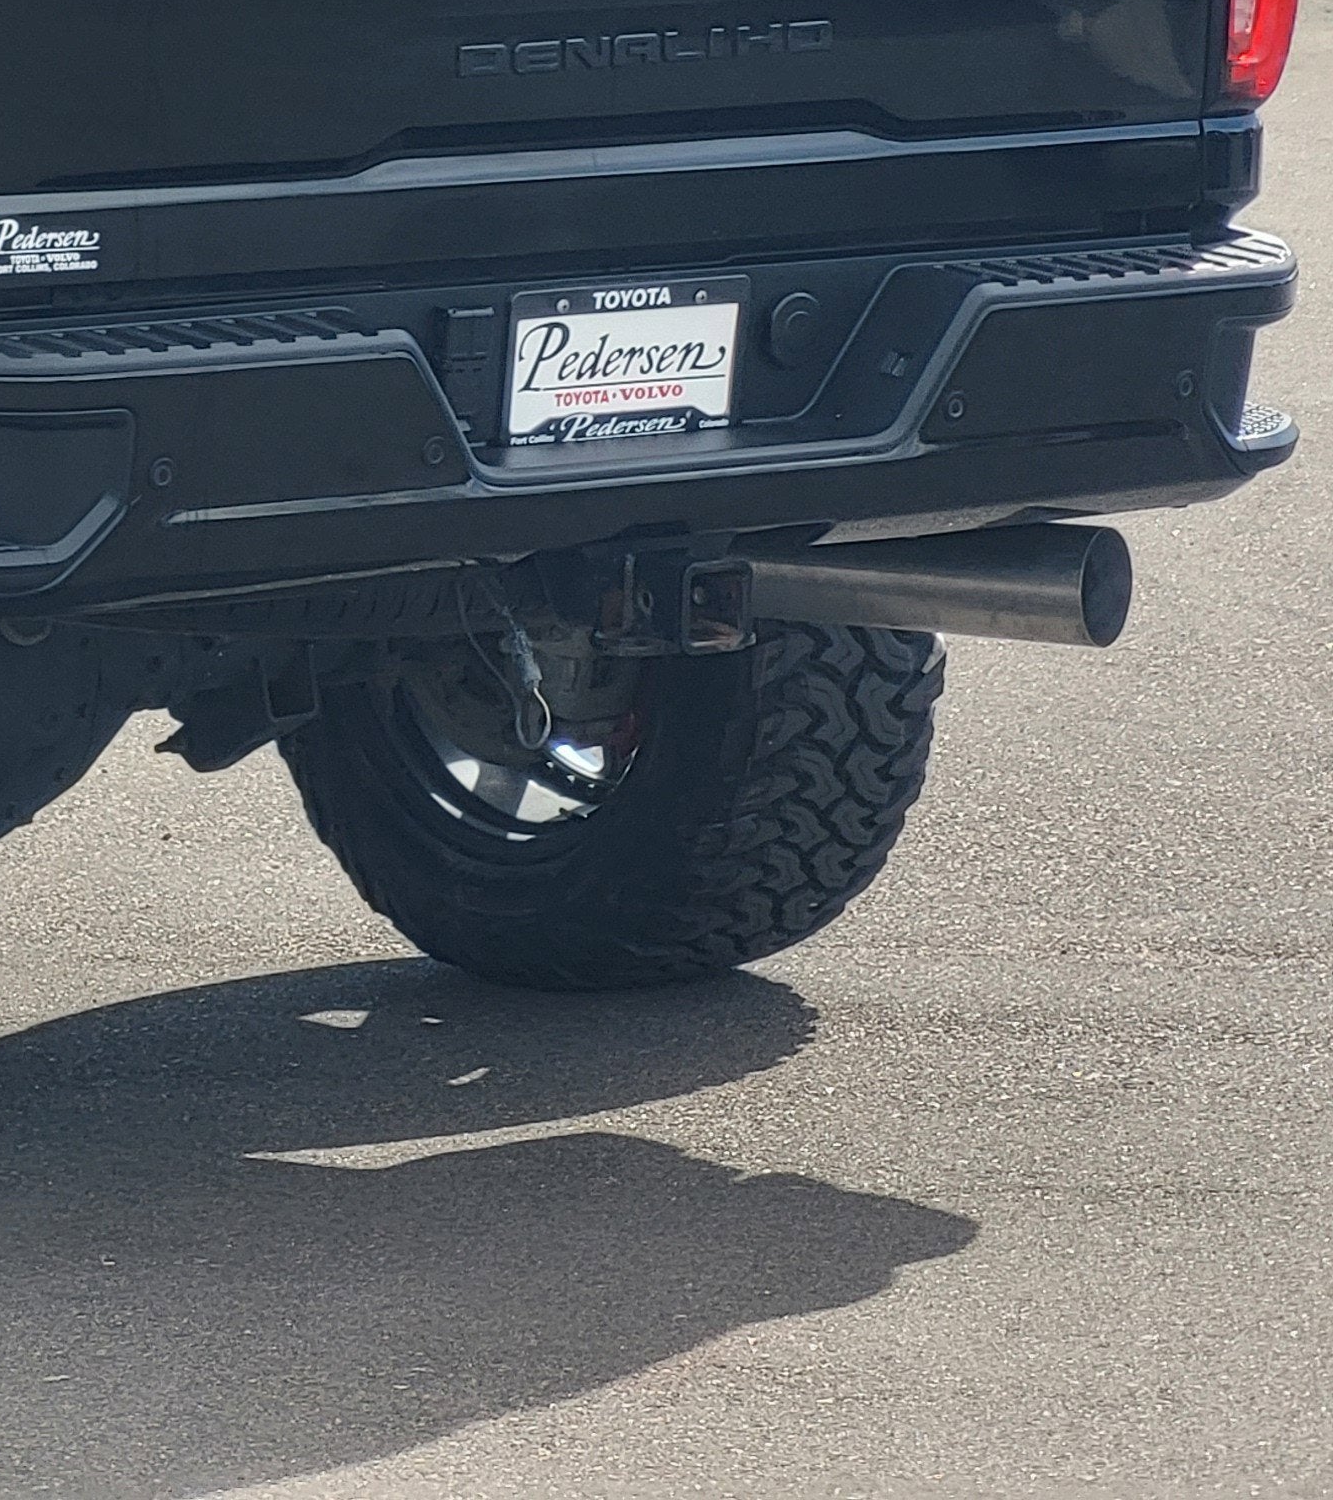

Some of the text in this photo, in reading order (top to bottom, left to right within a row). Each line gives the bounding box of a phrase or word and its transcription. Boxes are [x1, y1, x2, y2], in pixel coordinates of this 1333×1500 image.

[458, 20, 833, 78] DENALI HD
[10, 252, 81, 265] TOYOTA VOLVO
[592, 286, 672, 310] TOYOTA
[517, 321, 727, 393] Pedersen
[555, 384, 684, 407] TOYOTA VOLVO
[559, 412, 687, 443] Pedersen
